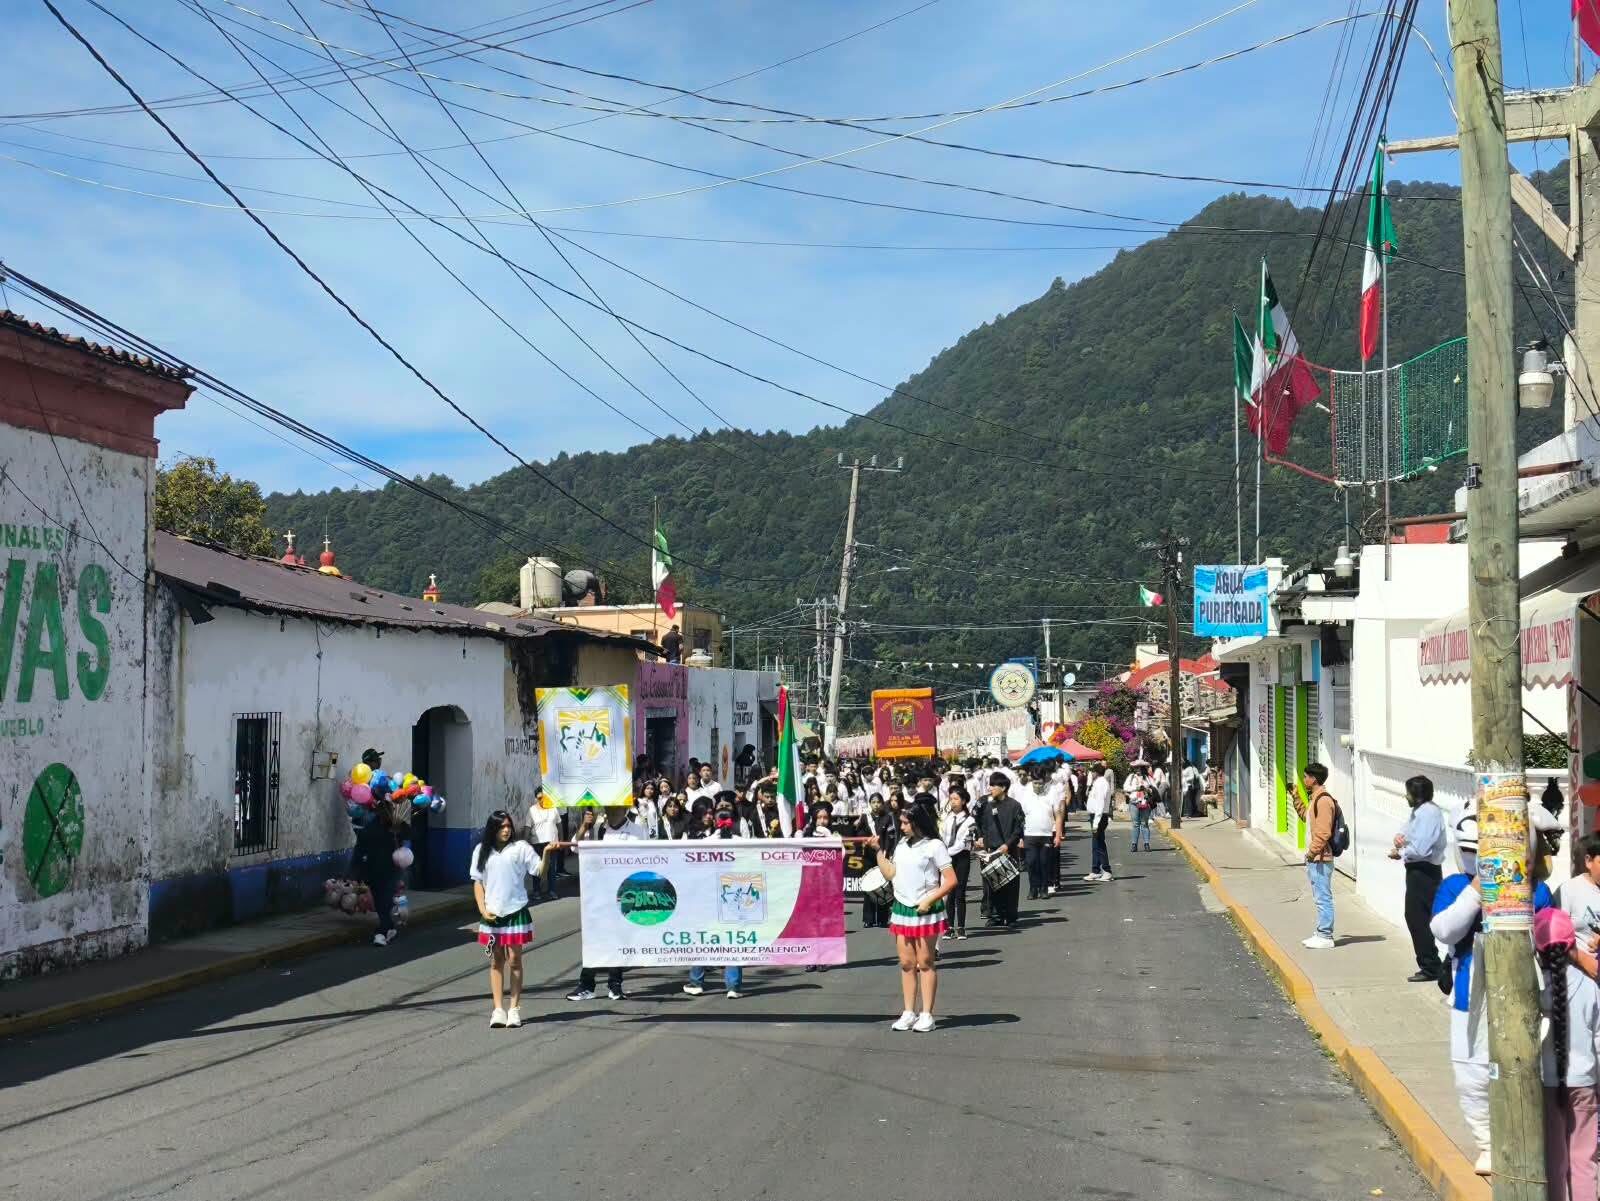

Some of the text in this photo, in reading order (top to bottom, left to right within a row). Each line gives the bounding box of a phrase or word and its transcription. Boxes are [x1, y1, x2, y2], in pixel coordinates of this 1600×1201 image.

[1215, 572, 1244, 594] AGUA
[1200, 601, 1262, 623] PURIFICADA
[604, 855, 669, 865] EDUCACIÓN
[685, 851, 736, 863] SEMS
[726, 931, 758, 944] 154
